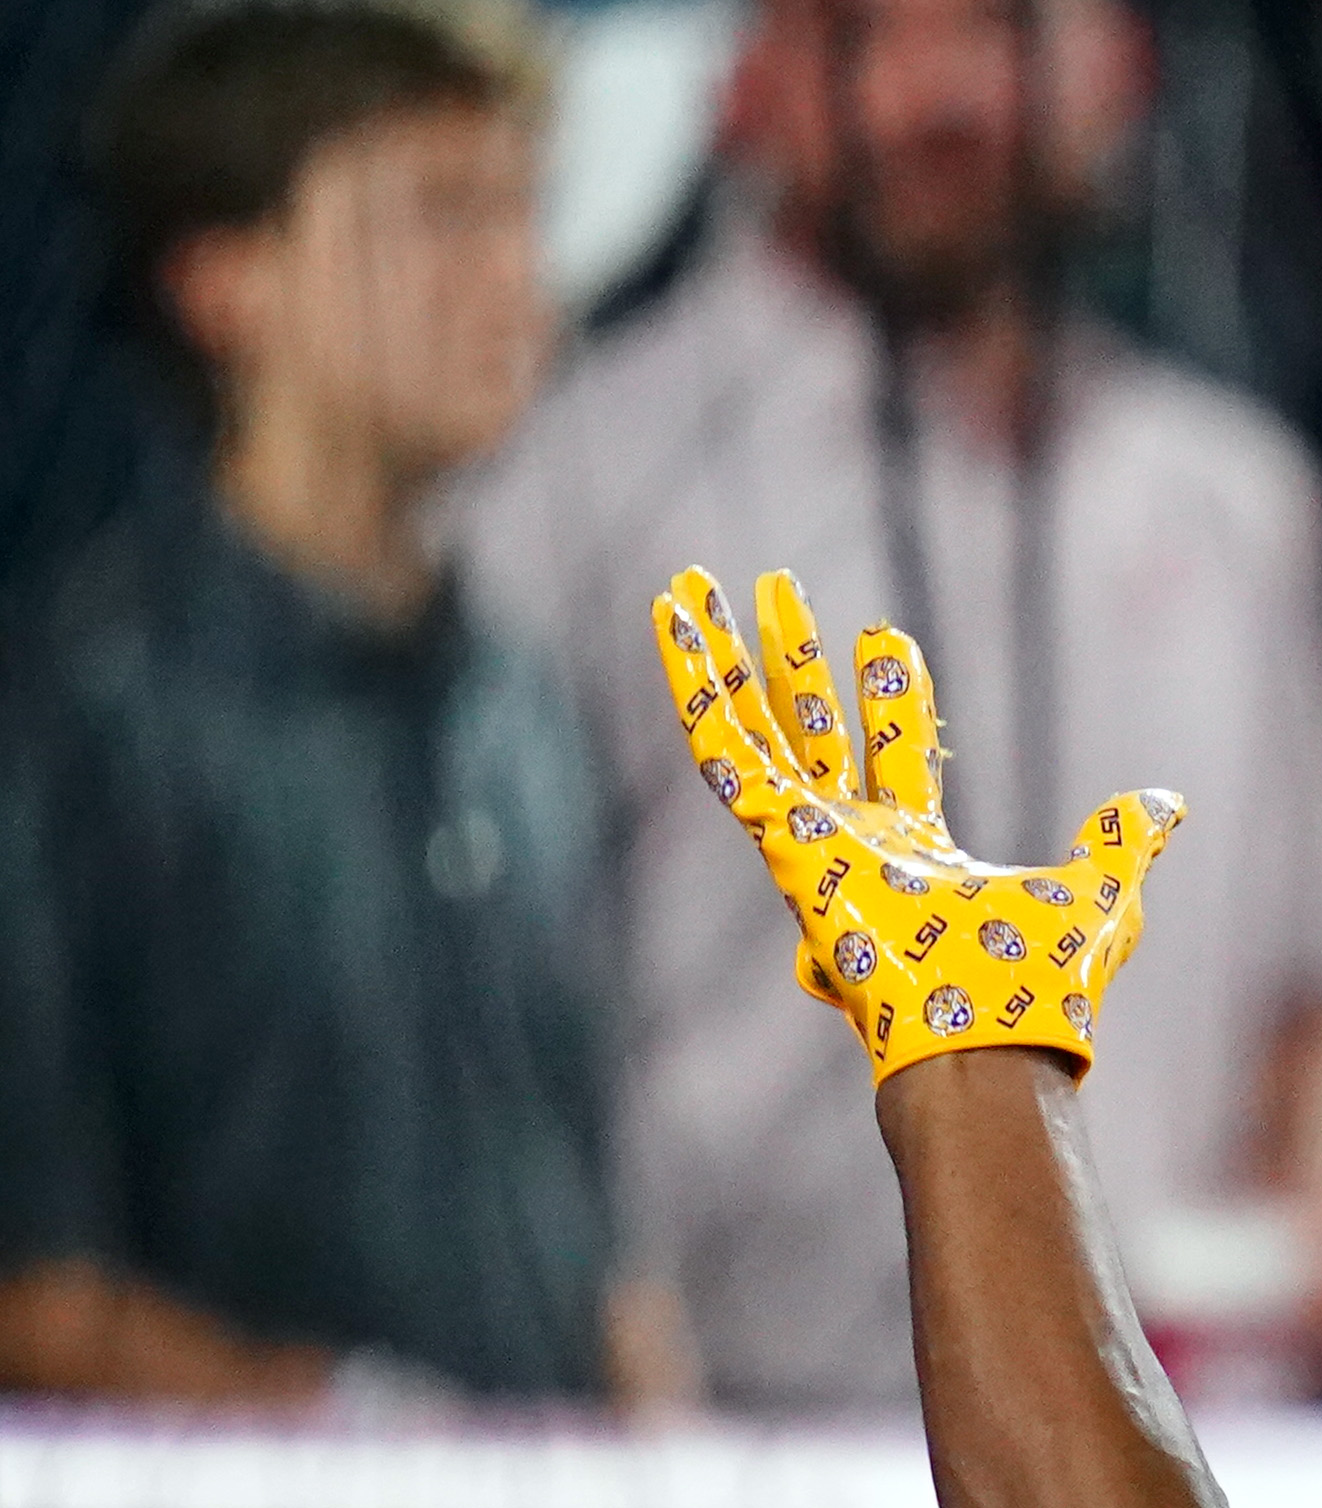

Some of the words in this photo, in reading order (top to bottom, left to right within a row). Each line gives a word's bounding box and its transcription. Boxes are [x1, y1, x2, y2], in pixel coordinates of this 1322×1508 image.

[1099, 807, 1123, 848] LSU
[813, 857, 851, 917] LSU
[1094, 873, 1122, 915] LSU
[904, 913, 948, 963] LSU
[1049, 925, 1087, 969] LSU
[996, 985, 1036, 1030] LSU
[875, 1002, 895, 1062] LSU
